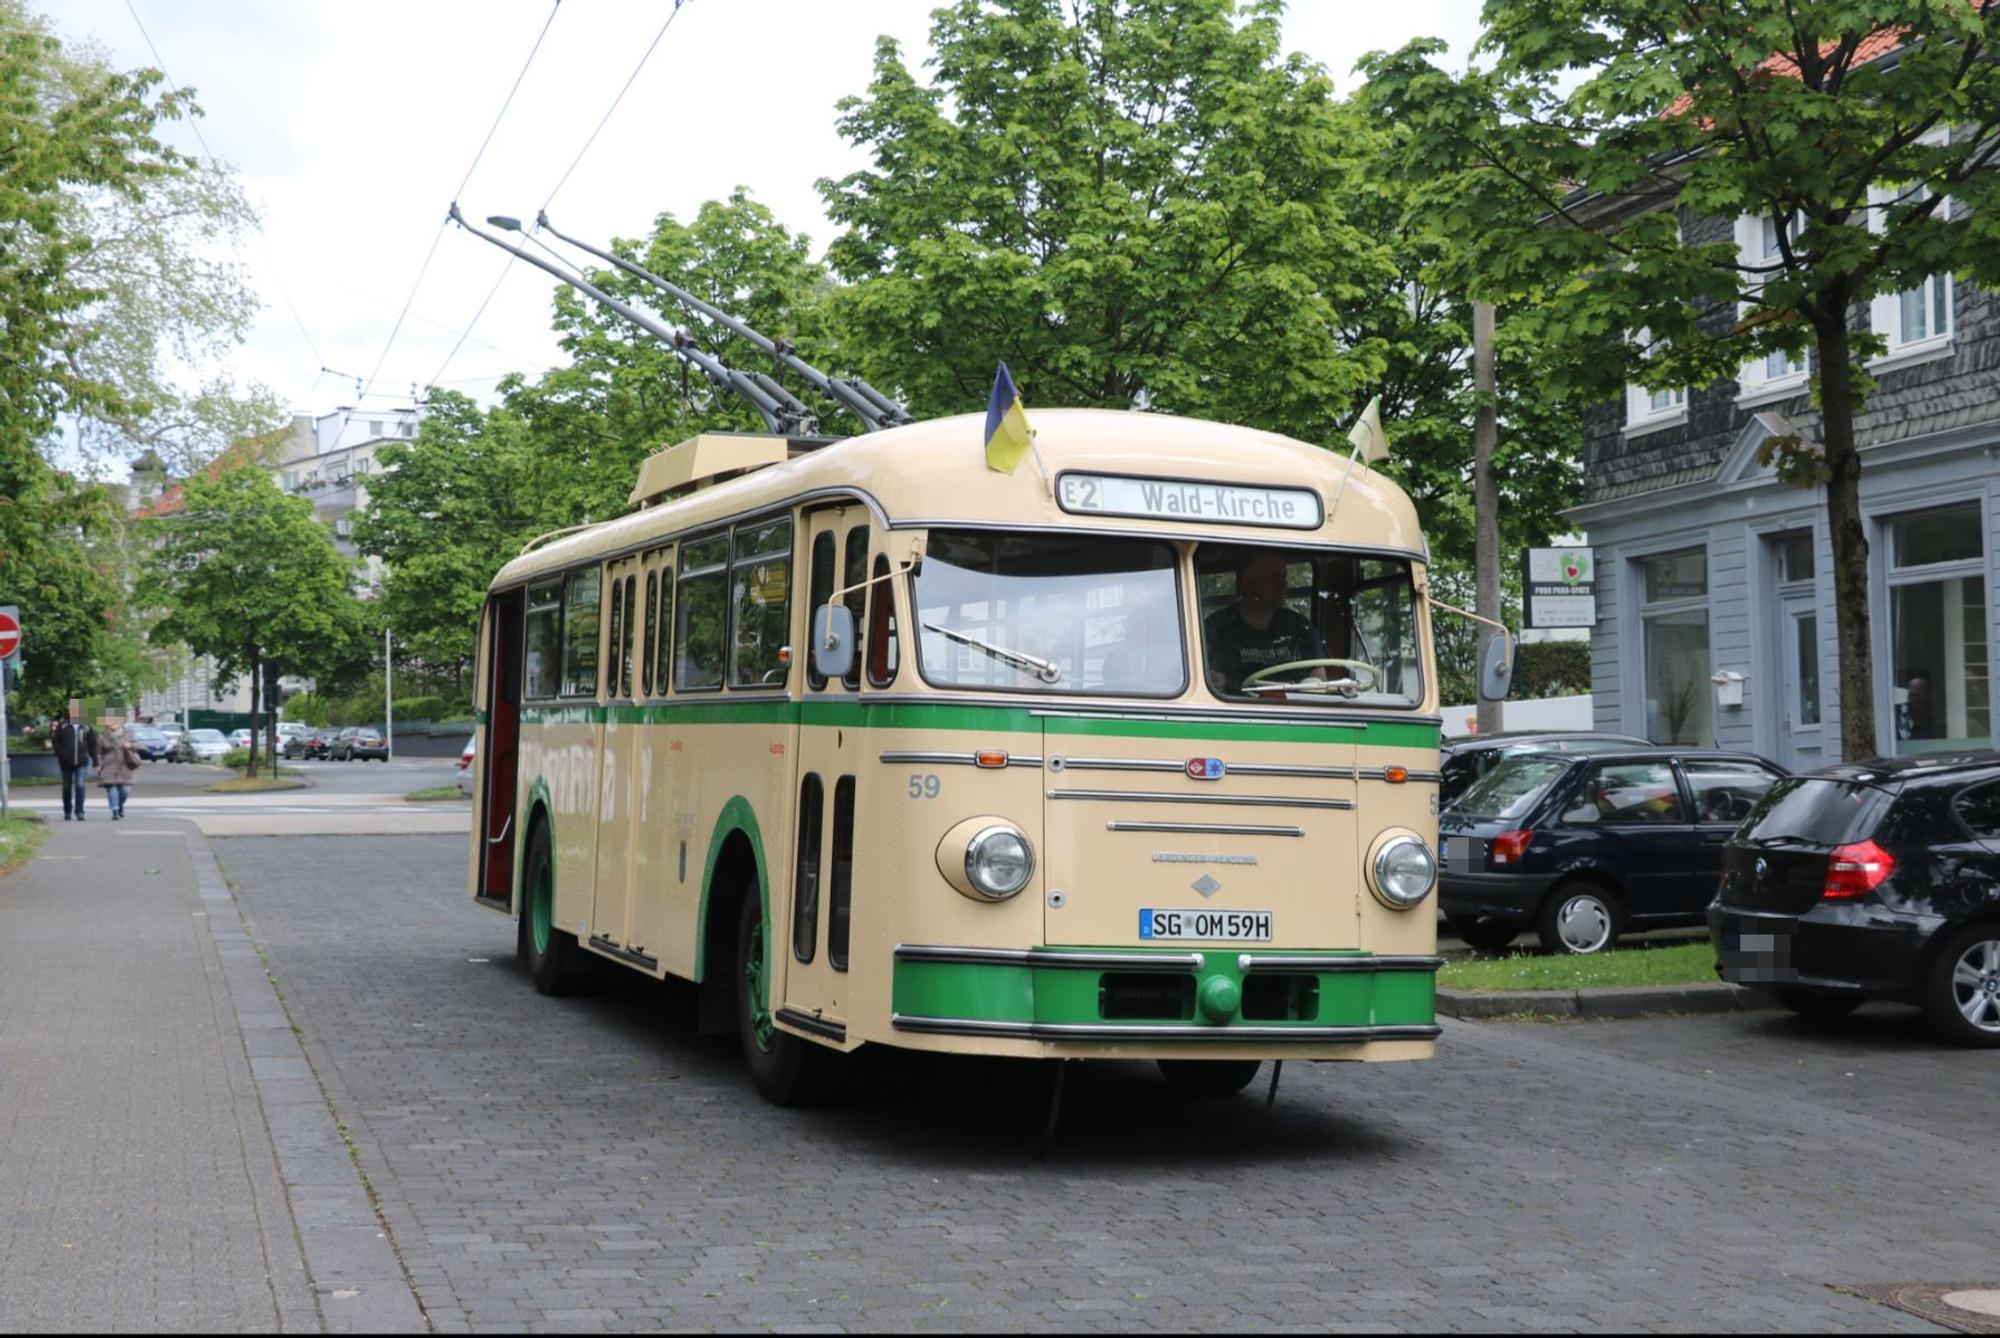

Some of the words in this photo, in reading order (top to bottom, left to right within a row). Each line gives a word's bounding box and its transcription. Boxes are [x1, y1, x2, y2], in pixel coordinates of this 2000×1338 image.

[1063, 479, 1098, 509] E2
[1139, 483, 1295, 520] Wald-Kirche
[908, 774, 941, 799] 59
[1153, 913, 1181, 936] SG
[1195, 913, 1223, 937] OM
[1228, 914, 1270, 938] 59H
